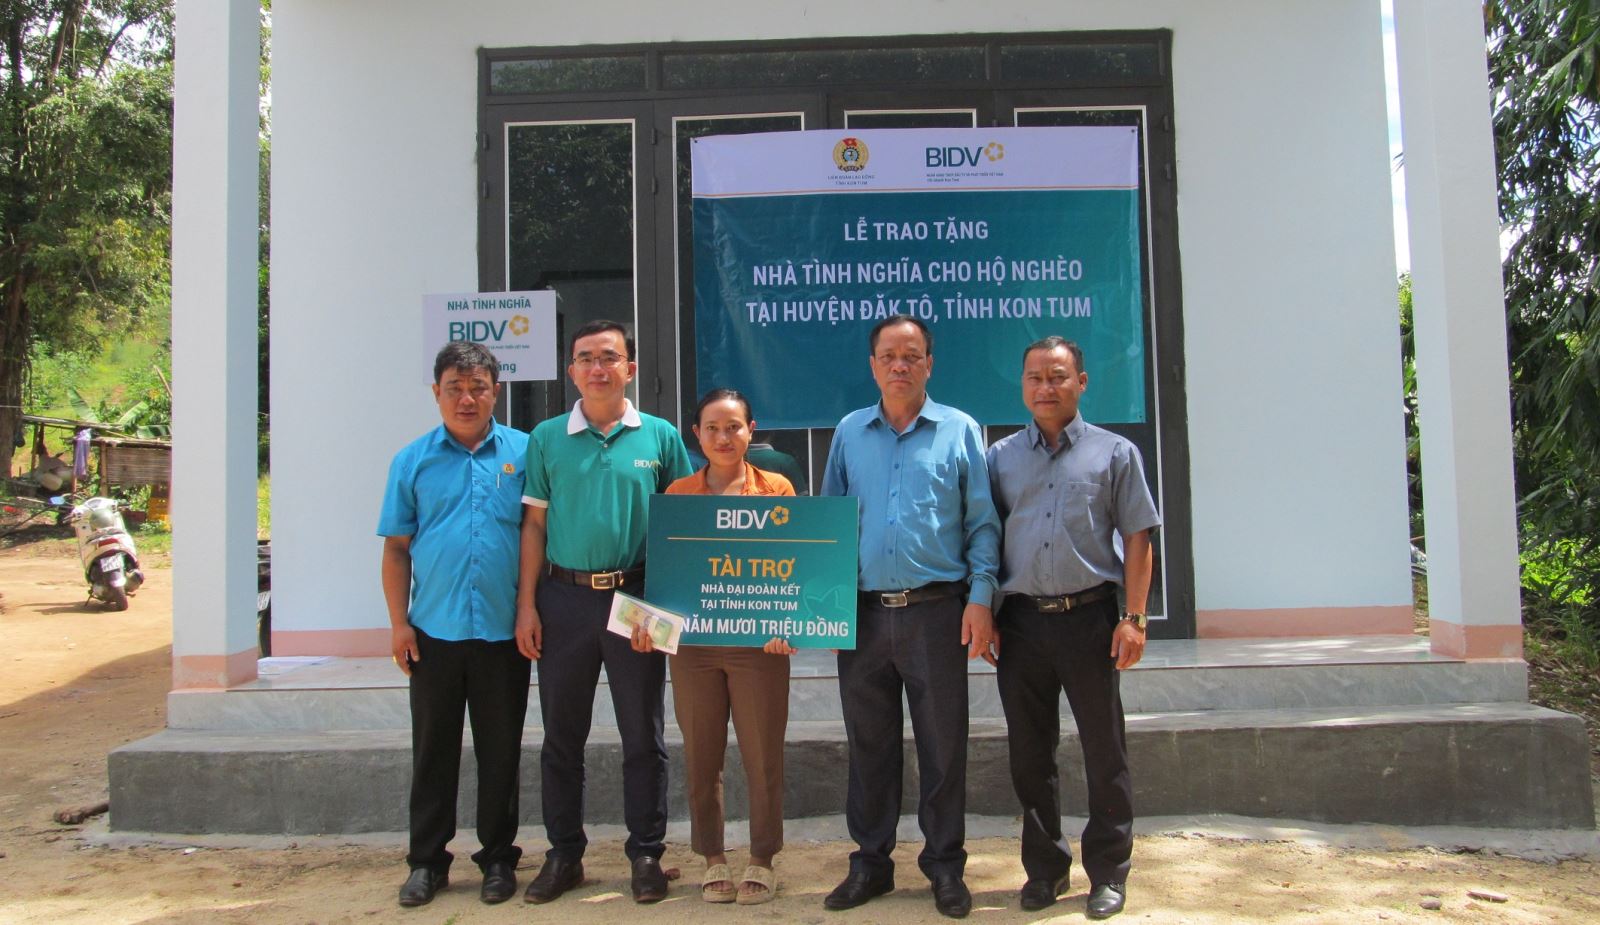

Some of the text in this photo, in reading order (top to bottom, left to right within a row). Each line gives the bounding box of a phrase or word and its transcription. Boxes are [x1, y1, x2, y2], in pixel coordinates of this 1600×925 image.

[926, 147, 984, 167] BIDV
[844, 216, 988, 243] LỄ TRAO TẶNG
[753, 255, 1082, 286] NHÀ TÌNH NGHĨA CHO HỘ NGHÈO
[447, 296, 531, 311] NHÀ TÌNH NGHĨA
[746, 291, 1091, 327] TẠI HUYỆN ĐĂK TÔ, TỈNH KON TUM
[449, 320, 508, 342] BIDV
[634, 459, 653, 469] BIDV
[716, 509, 770, 529] BIDV
[708, 554, 795, 582] TÀI TRỢ
[701, 582, 800, 596] NHÀ ĐẠI ĐOÀN KẾT
[701, 597, 798, 611] TẠI TỈNH KON TUM
[680, 614, 849, 639] NĂM MƯƠI TRIỆU ĐỒNG
